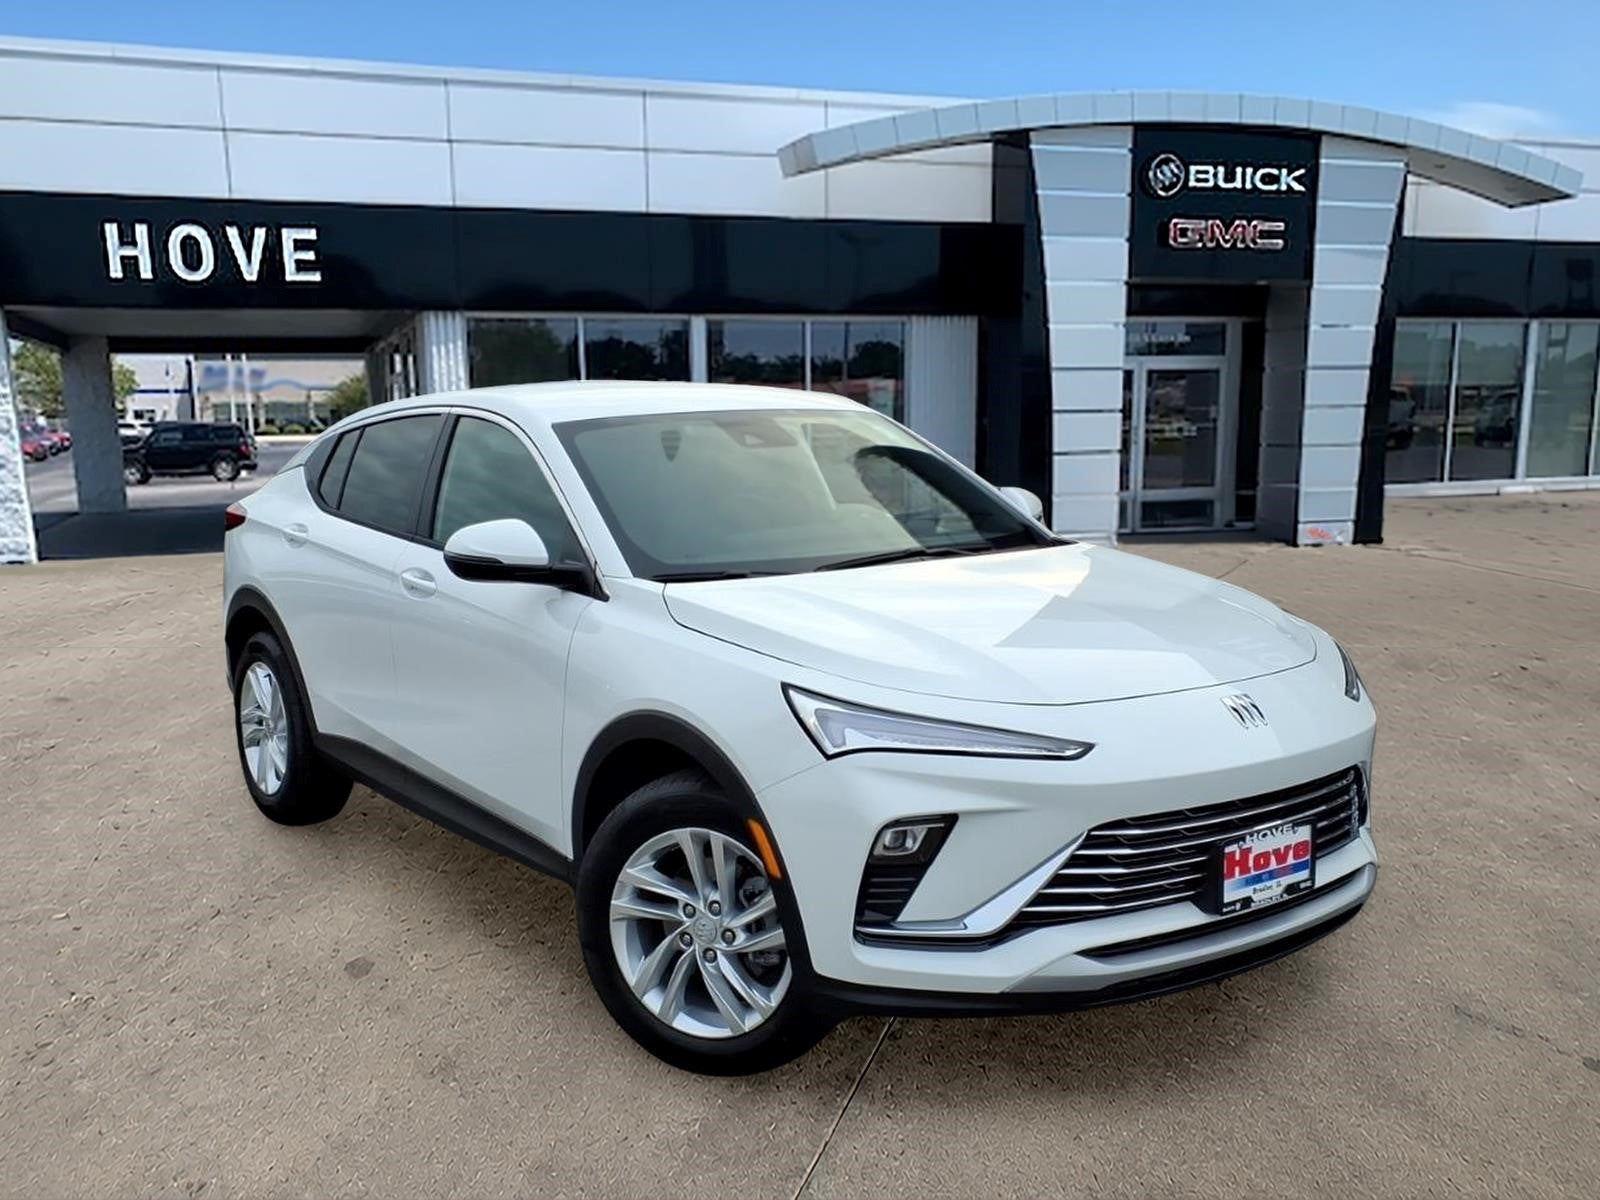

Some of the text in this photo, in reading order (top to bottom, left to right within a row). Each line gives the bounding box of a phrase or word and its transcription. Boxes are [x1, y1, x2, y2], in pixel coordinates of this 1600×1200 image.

[1188, 164, 1306, 192] BUICK
[1169, 217, 1285, 249] GMC
[104, 222, 322, 282] HOVE
[1225, 839, 1310, 880] Hove
